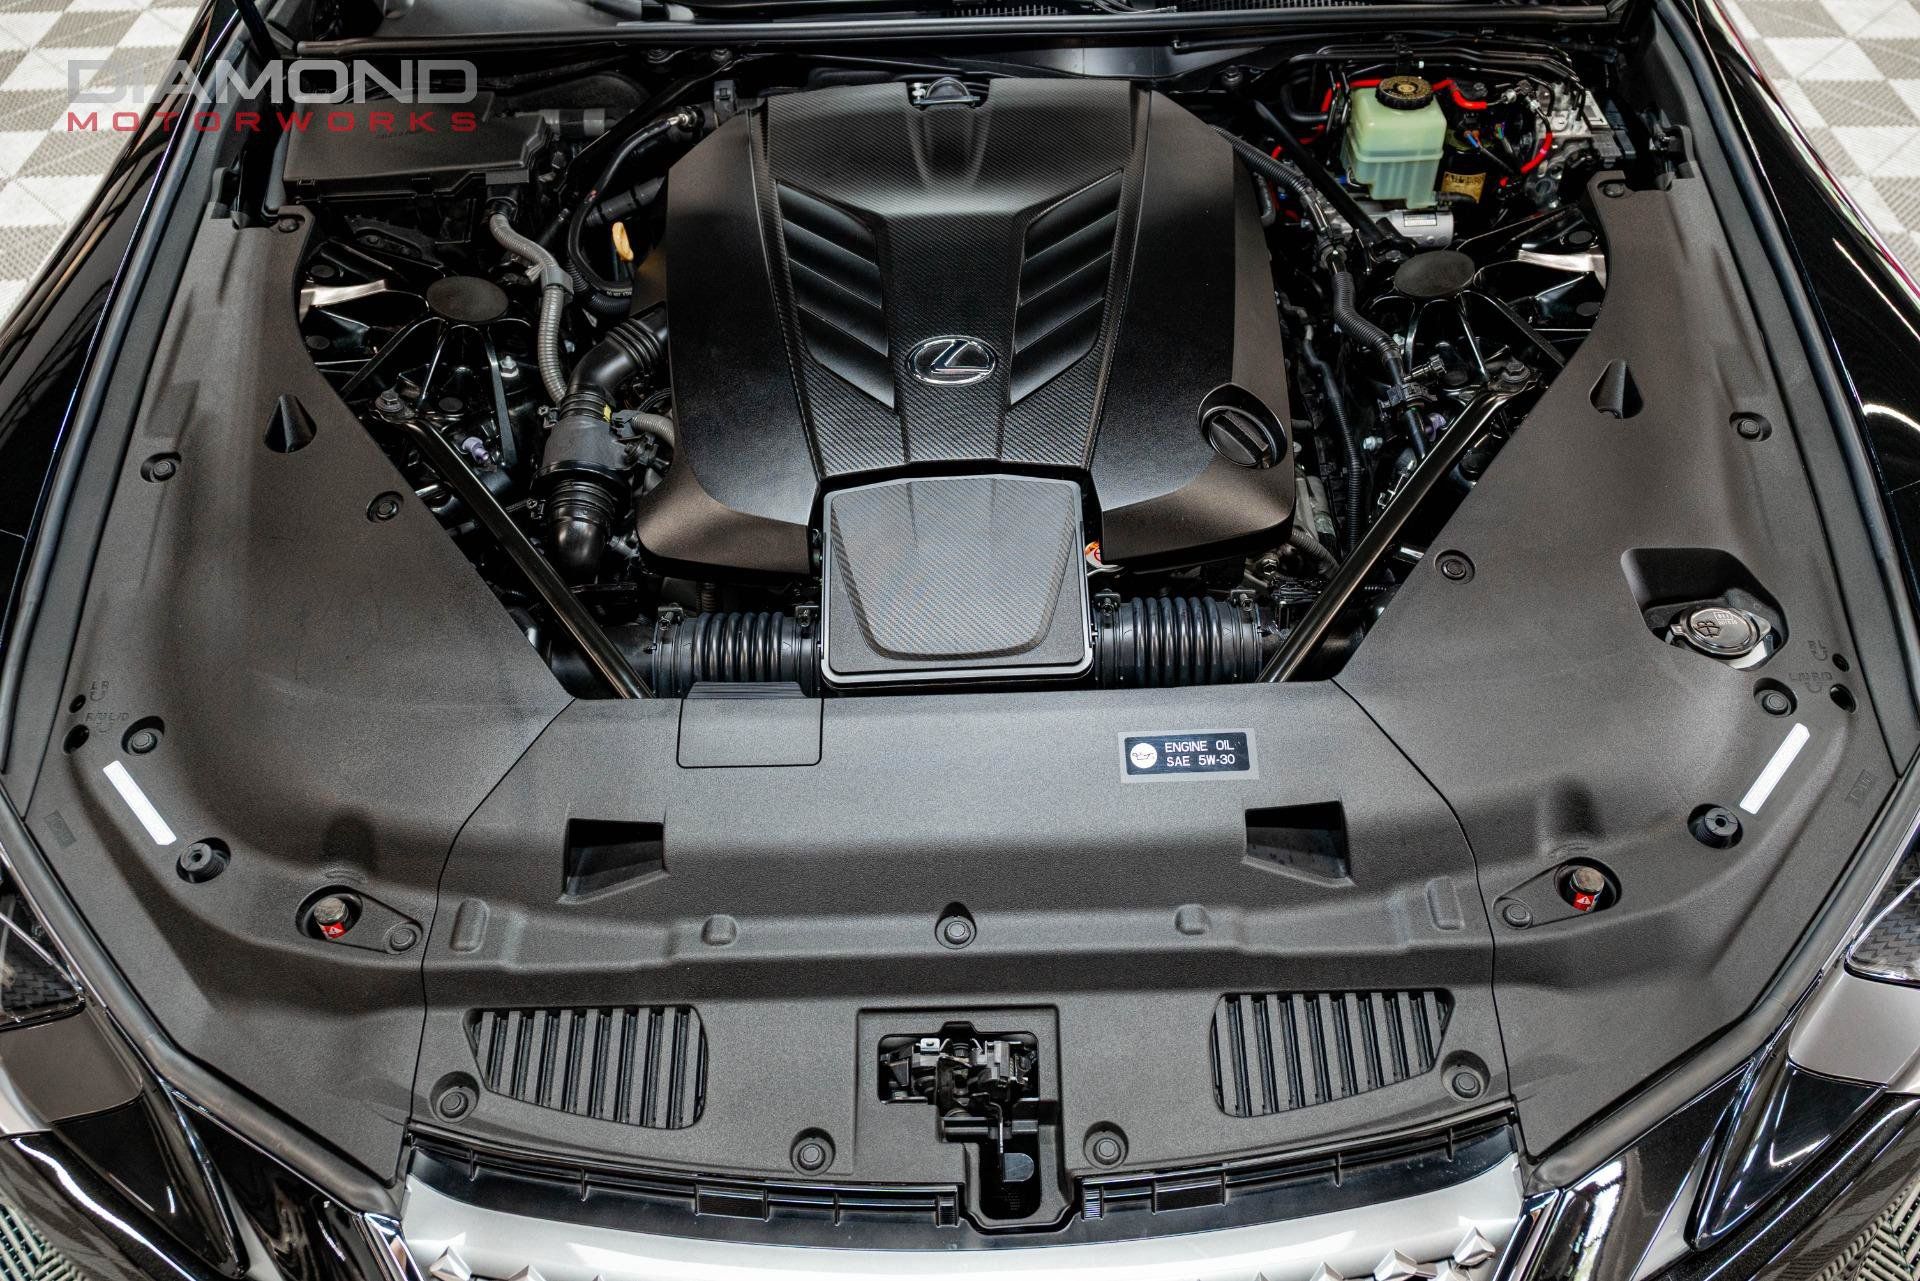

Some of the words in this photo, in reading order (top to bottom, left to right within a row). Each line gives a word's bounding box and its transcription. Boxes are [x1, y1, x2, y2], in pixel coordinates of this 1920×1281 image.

[1164, 740, 1208, 753] ENGINE
[1215, 739, 1235, 751] OIL
[1166, 757, 1191, 767] SAE
[1198, 754, 1236, 766] 5W-30
